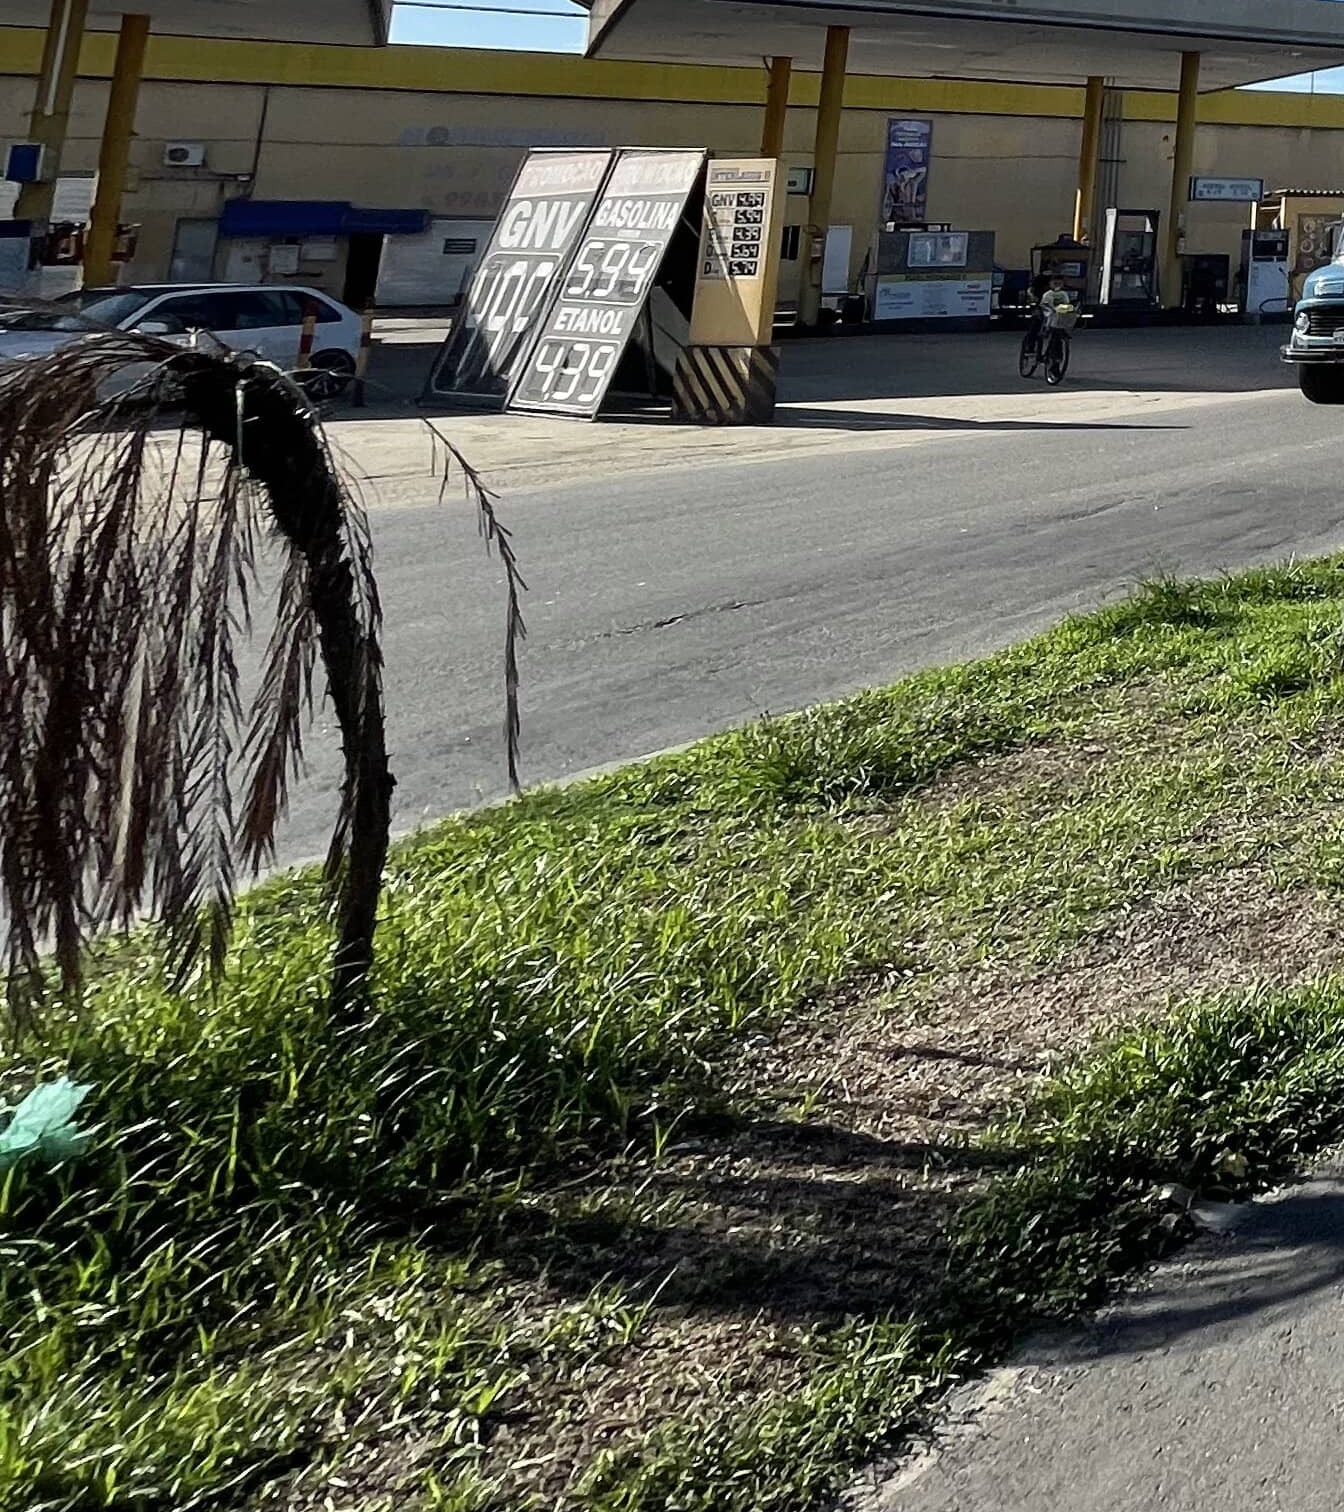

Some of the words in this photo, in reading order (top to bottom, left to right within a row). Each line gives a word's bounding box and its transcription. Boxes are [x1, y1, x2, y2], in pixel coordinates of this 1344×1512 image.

[594, 199, 680, 230] GASOLINA
[711, 193, 736, 207] GNV
[499, 200, 586, 249] GNV
[553, 306, 624, 335] ETANOL
